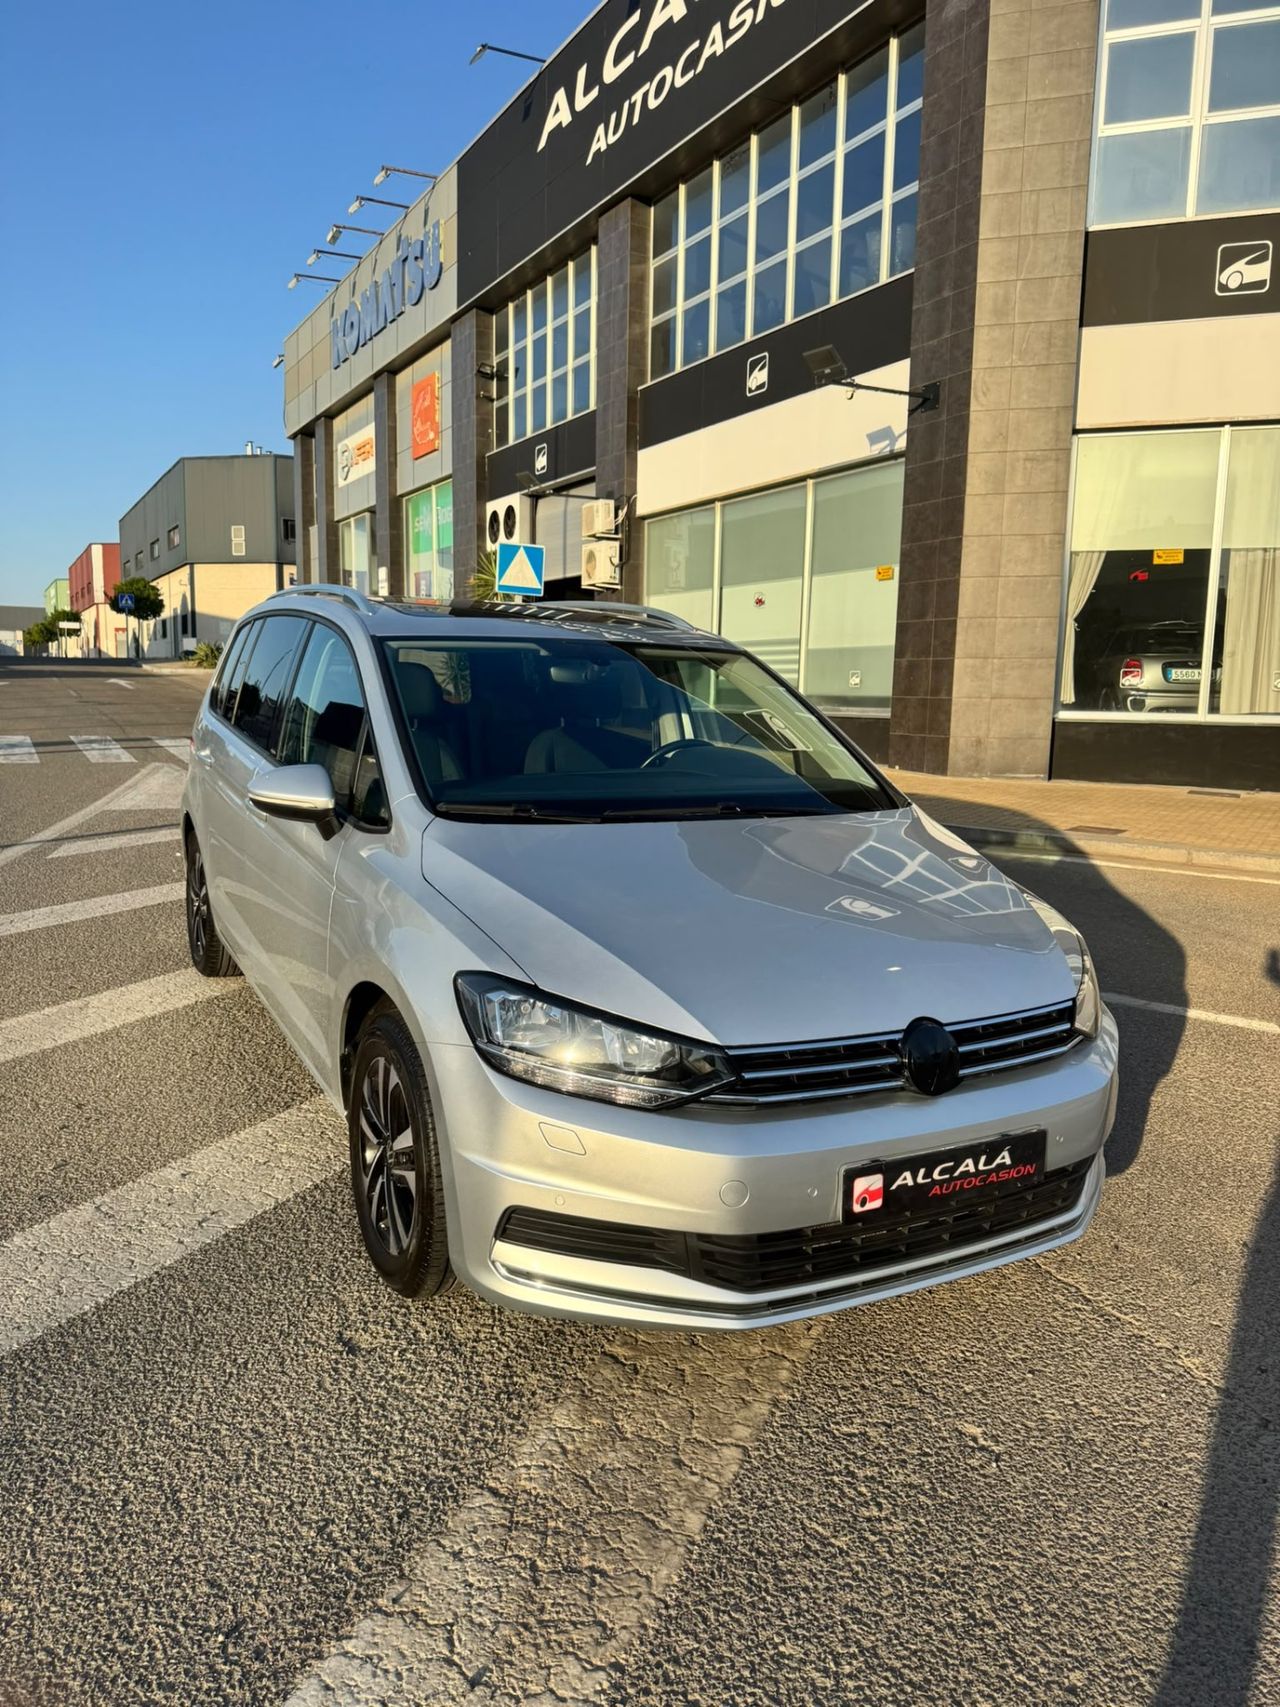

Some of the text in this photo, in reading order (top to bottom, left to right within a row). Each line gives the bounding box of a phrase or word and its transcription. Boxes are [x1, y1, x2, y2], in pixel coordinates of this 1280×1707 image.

[537, 0, 700, 153] ALCA
[586, 0, 787, 166] AUTOCASI
[331, 219, 443, 370] KOMATSU
[889, 1146, 1012, 1190] ALCALÁ
[928, 1164, 1036, 1197] AUTOCASIÓN
